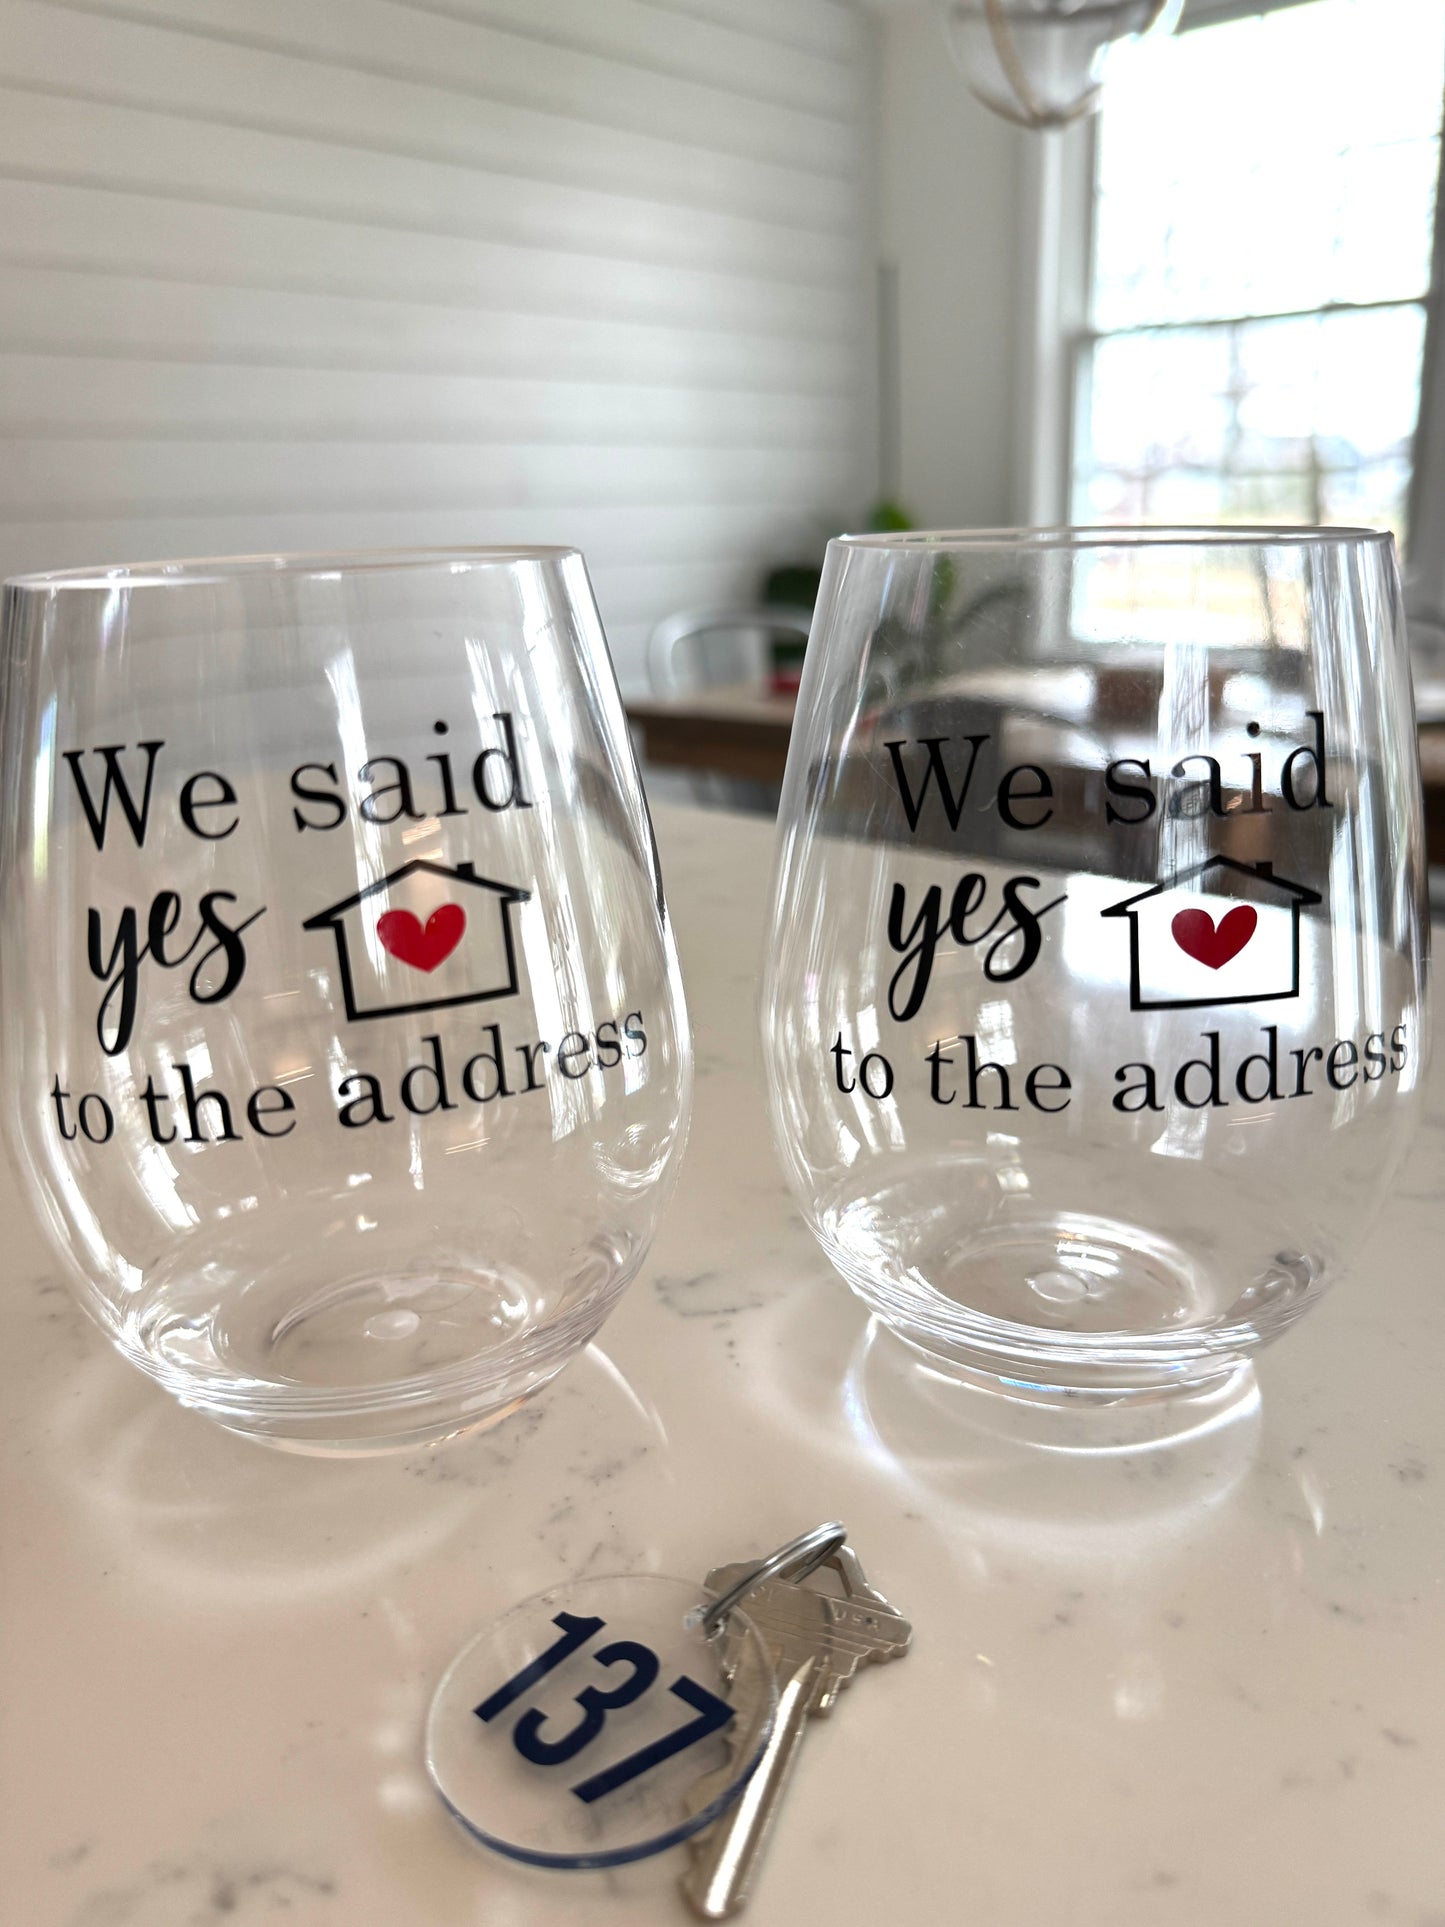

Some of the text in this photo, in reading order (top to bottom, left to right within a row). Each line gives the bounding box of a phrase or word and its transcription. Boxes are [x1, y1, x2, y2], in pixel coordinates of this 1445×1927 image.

[63, 713, 533, 851] We said
[884, 711, 1334, 832] We said
[87, 890, 266, 1056] yes
[887, 872, 1068, 1022] yes
[50, 1010, 648, 1144] to the address
[830, 1022, 1409, 1113] to the address
[473, 1611, 736, 1803] 137
